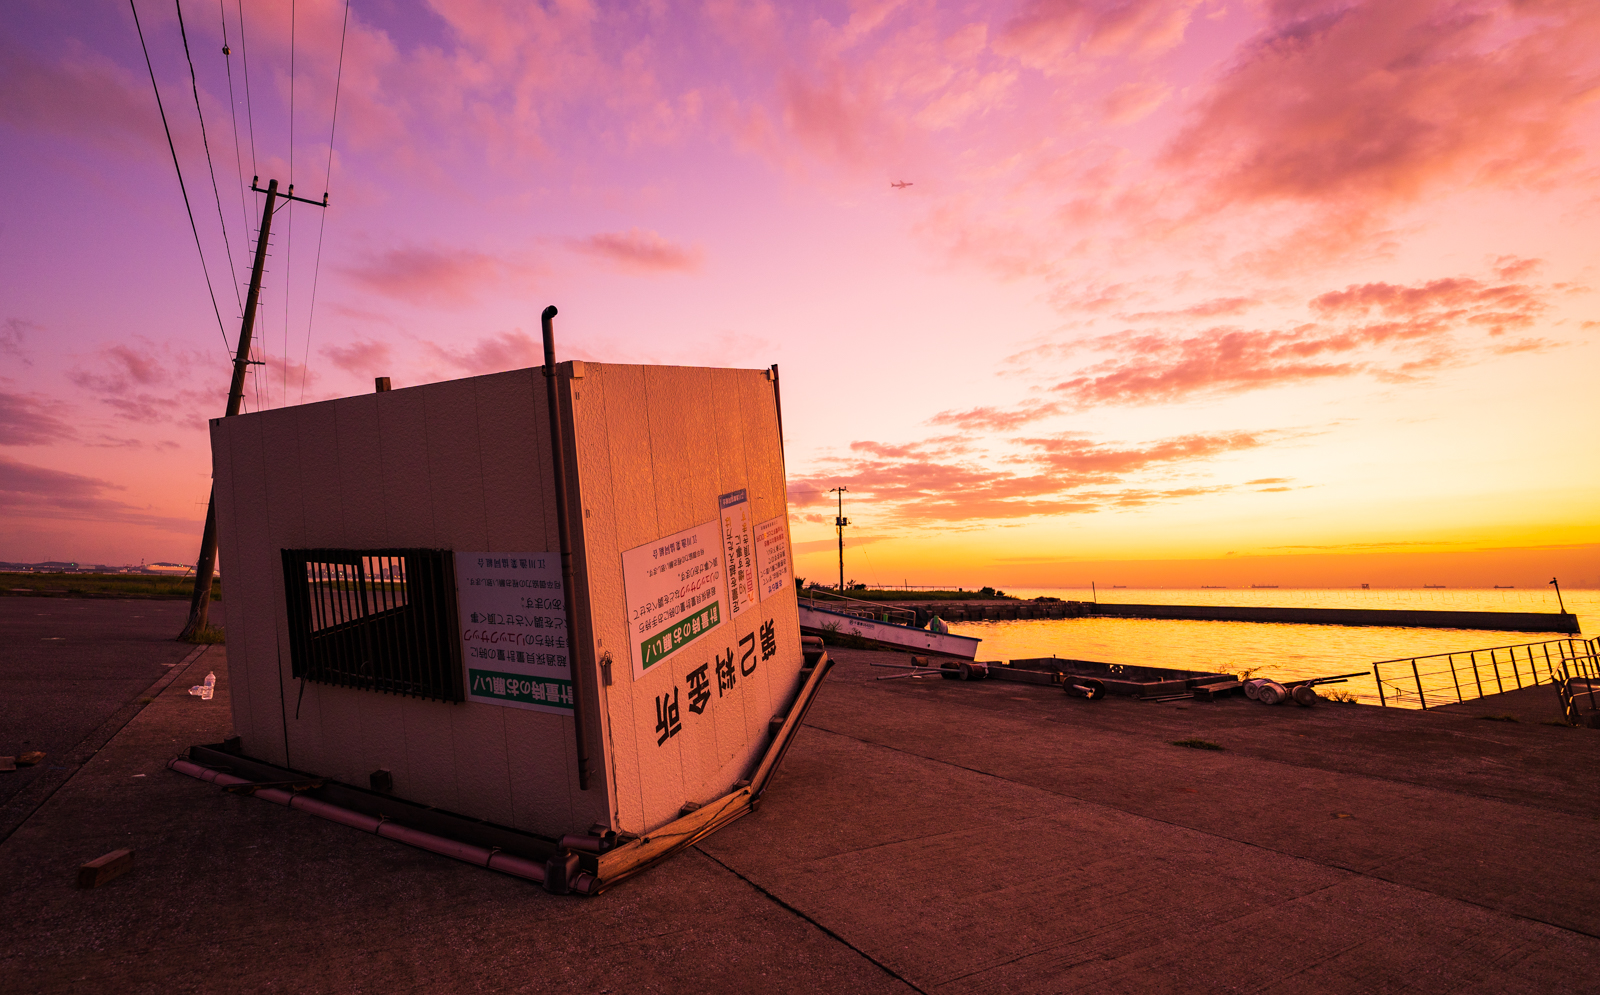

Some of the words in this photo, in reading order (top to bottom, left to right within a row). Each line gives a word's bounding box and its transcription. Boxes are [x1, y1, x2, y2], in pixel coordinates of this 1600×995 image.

[477, 558, 546, 569] 江川漁業協同組合
[521, 597, 567, 611] あります。
[645, 606, 717, 663] 計量時のお願い!
[470, 646, 567, 668] 超過採貝量計量の時に
[655, 618, 777, 747] 第2料金所
